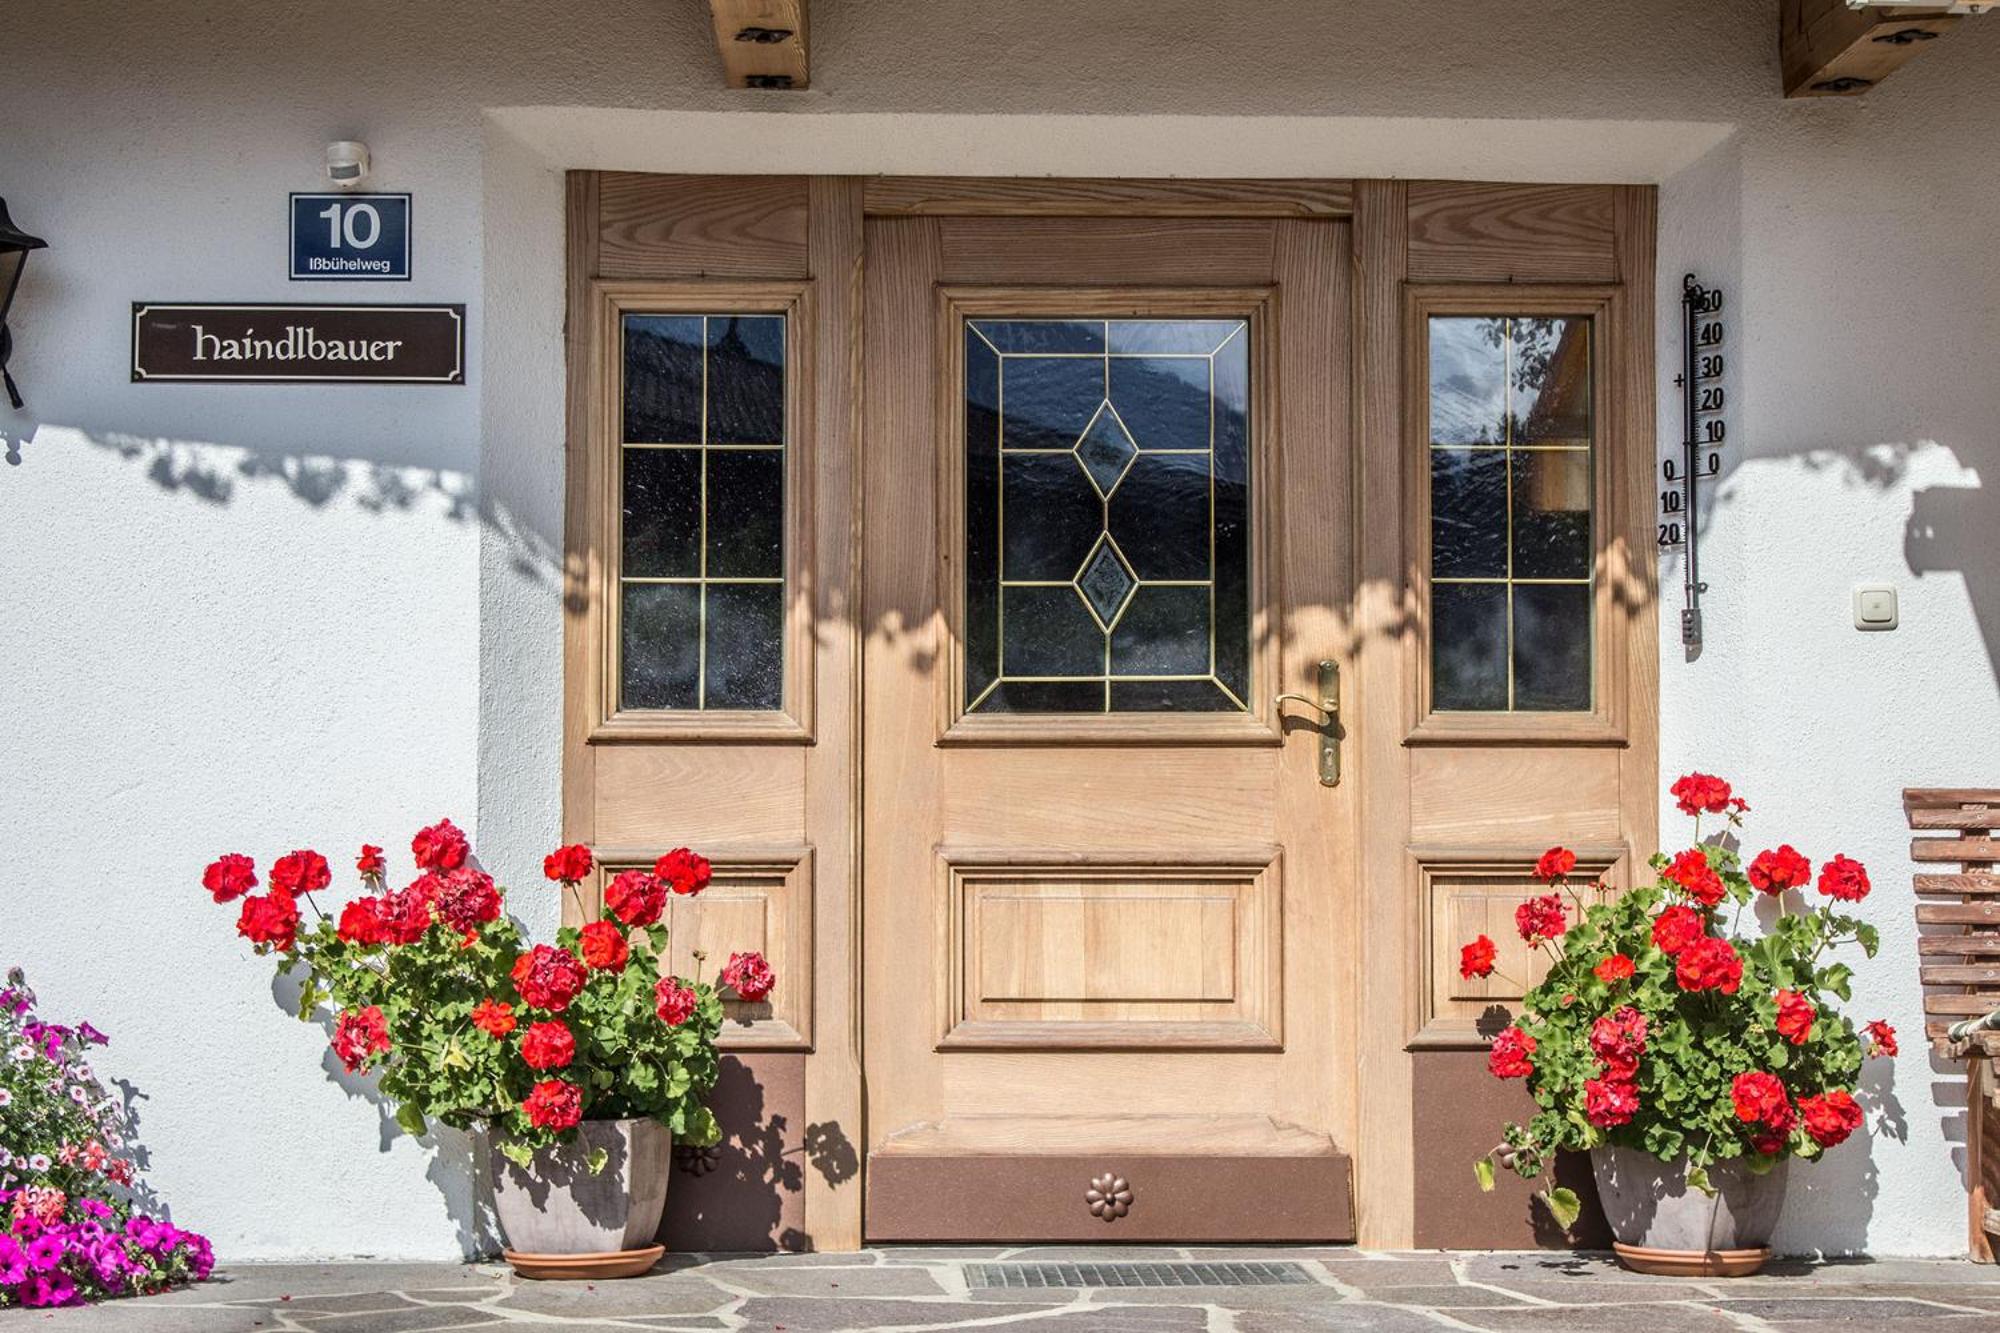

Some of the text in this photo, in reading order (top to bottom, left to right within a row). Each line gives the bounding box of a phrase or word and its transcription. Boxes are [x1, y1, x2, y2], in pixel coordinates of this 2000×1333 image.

[320, 203, 381, 249] 10
[309, 258, 391, 272] Ißbühelweg
[191, 324, 403, 361] haindlbauer
[1701, 322, 1723, 344] 40
[1701, 355, 1724, 377] 30
[1702, 387, 1724, 410] 20
[1705, 420, 1725, 441] 10
[1663, 459, 1675, 481] 0
[1708, 452, 1720, 473] 0
[1660, 490, 1680, 513] 10
[1657, 523, 1680, 545] 20
